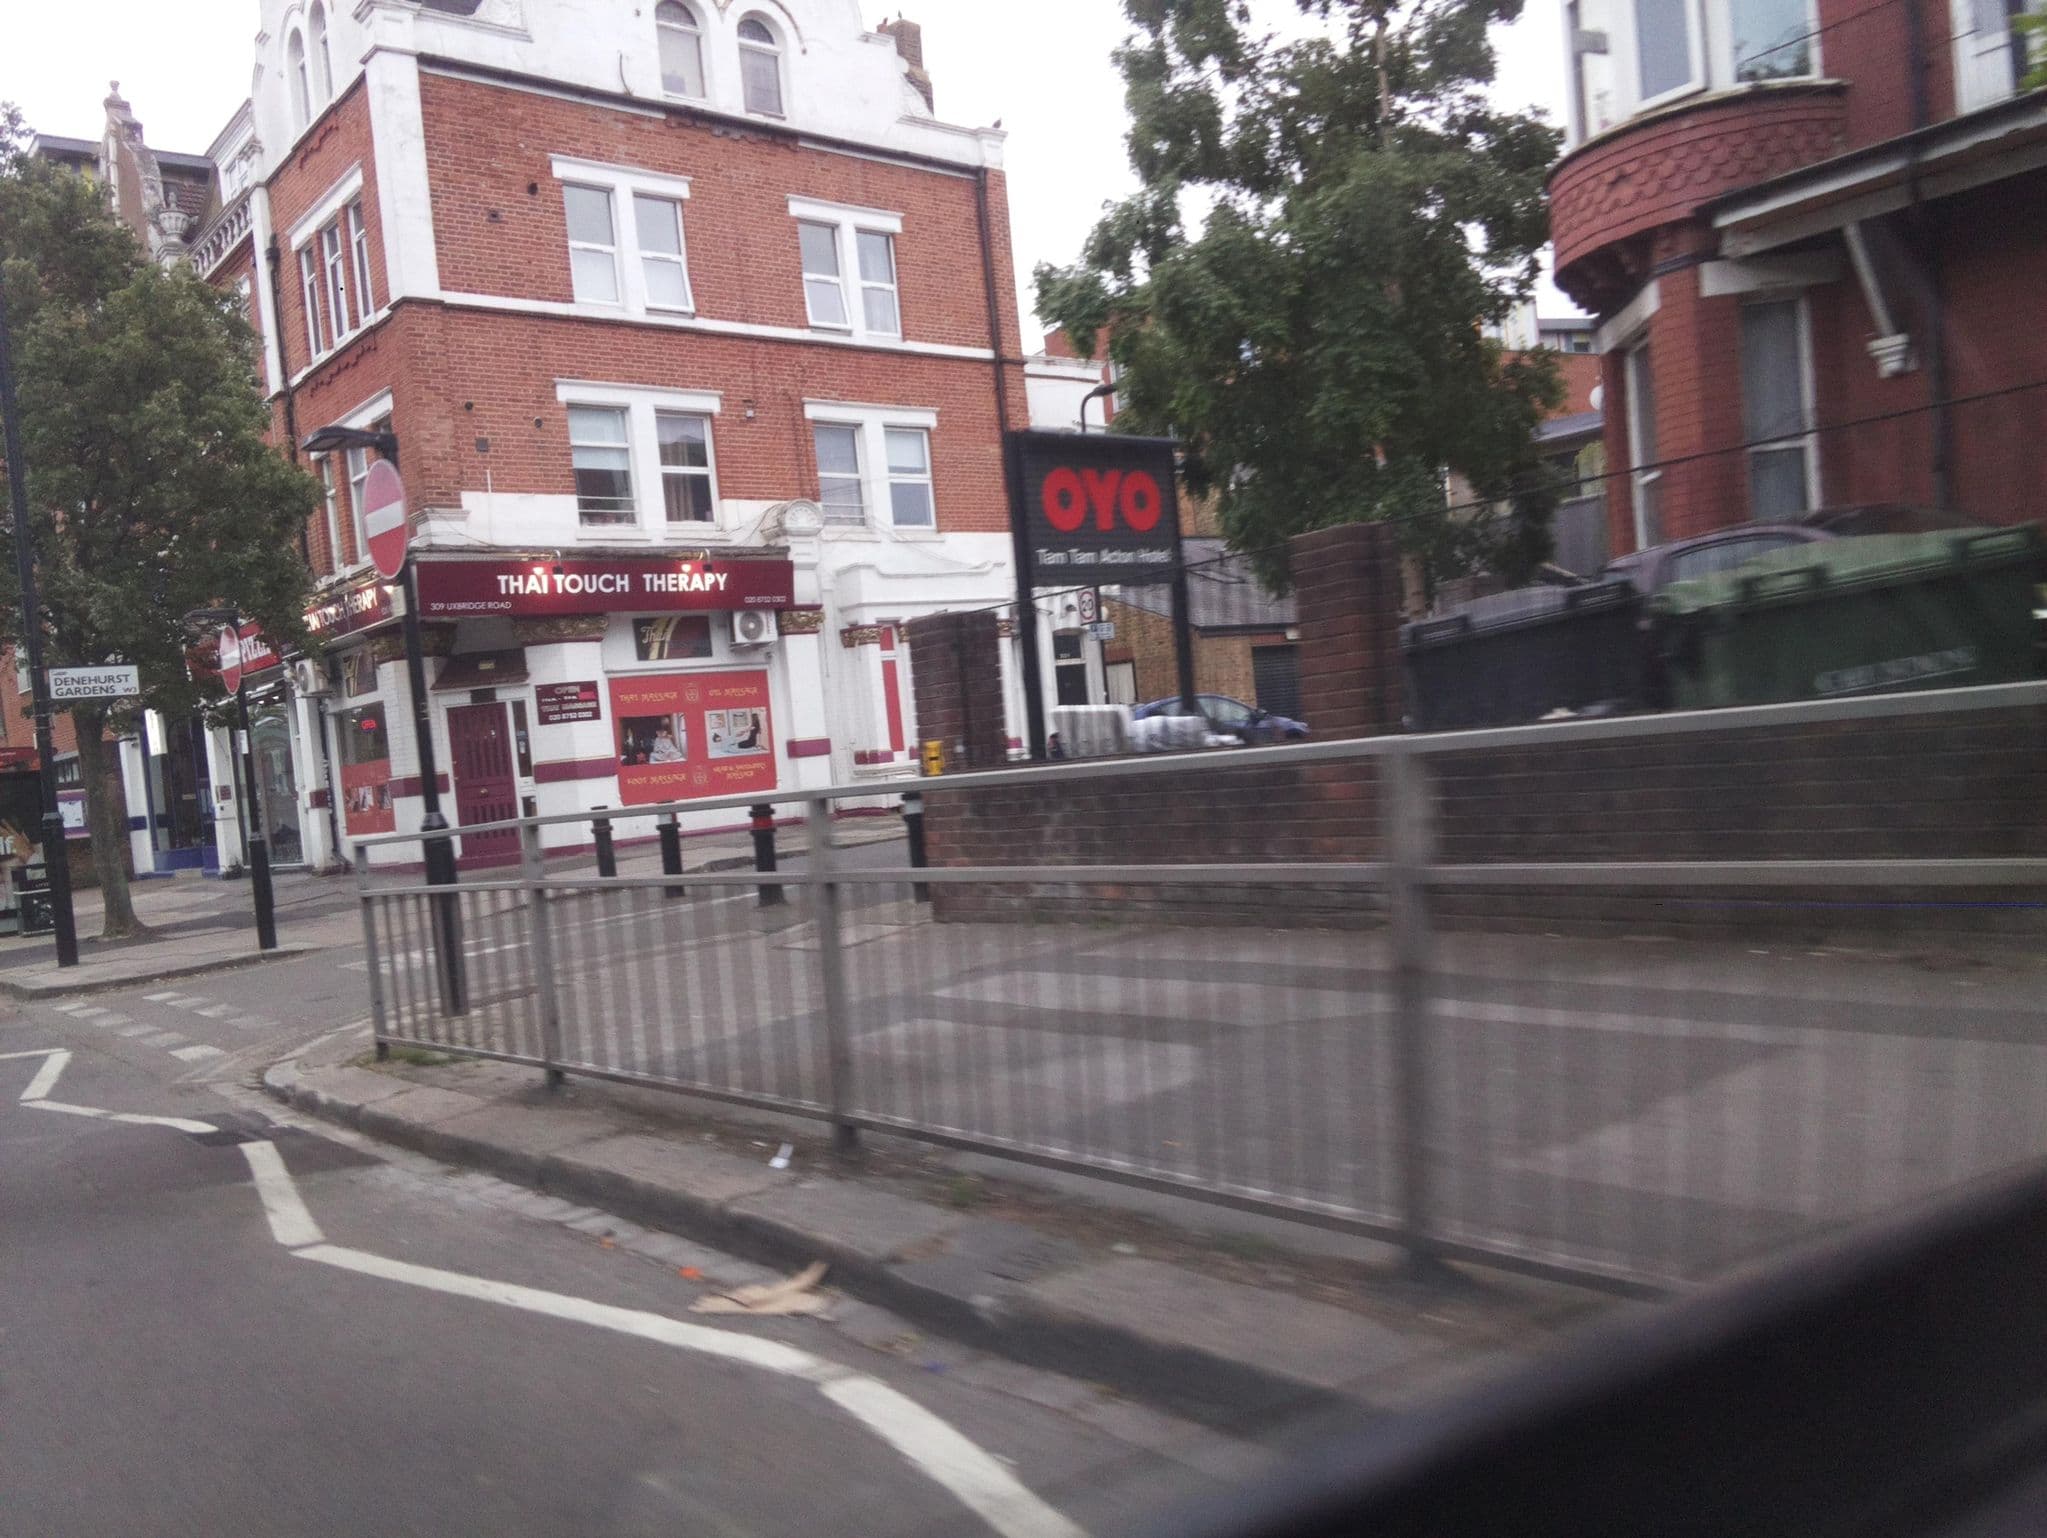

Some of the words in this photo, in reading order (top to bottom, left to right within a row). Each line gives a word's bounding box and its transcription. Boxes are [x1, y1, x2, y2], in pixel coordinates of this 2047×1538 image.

[1041, 467, 1162, 532] OYO
[1036, 549, 1067, 565] Tam
[1068, 549, 1098, 564] Tam
[497, 574, 548, 594] THAI
[553, 574, 630, 594] TOUCH
[643, 573, 727, 592] THERAPY
[431, 602, 444, 611] 309
[447, 602, 486, 610] UXBRIDGE
[1081, 599, 1094, 611] 20
[54, 673, 130, 686] DENEHURST
[55, 685, 116, 697] GARDENS
